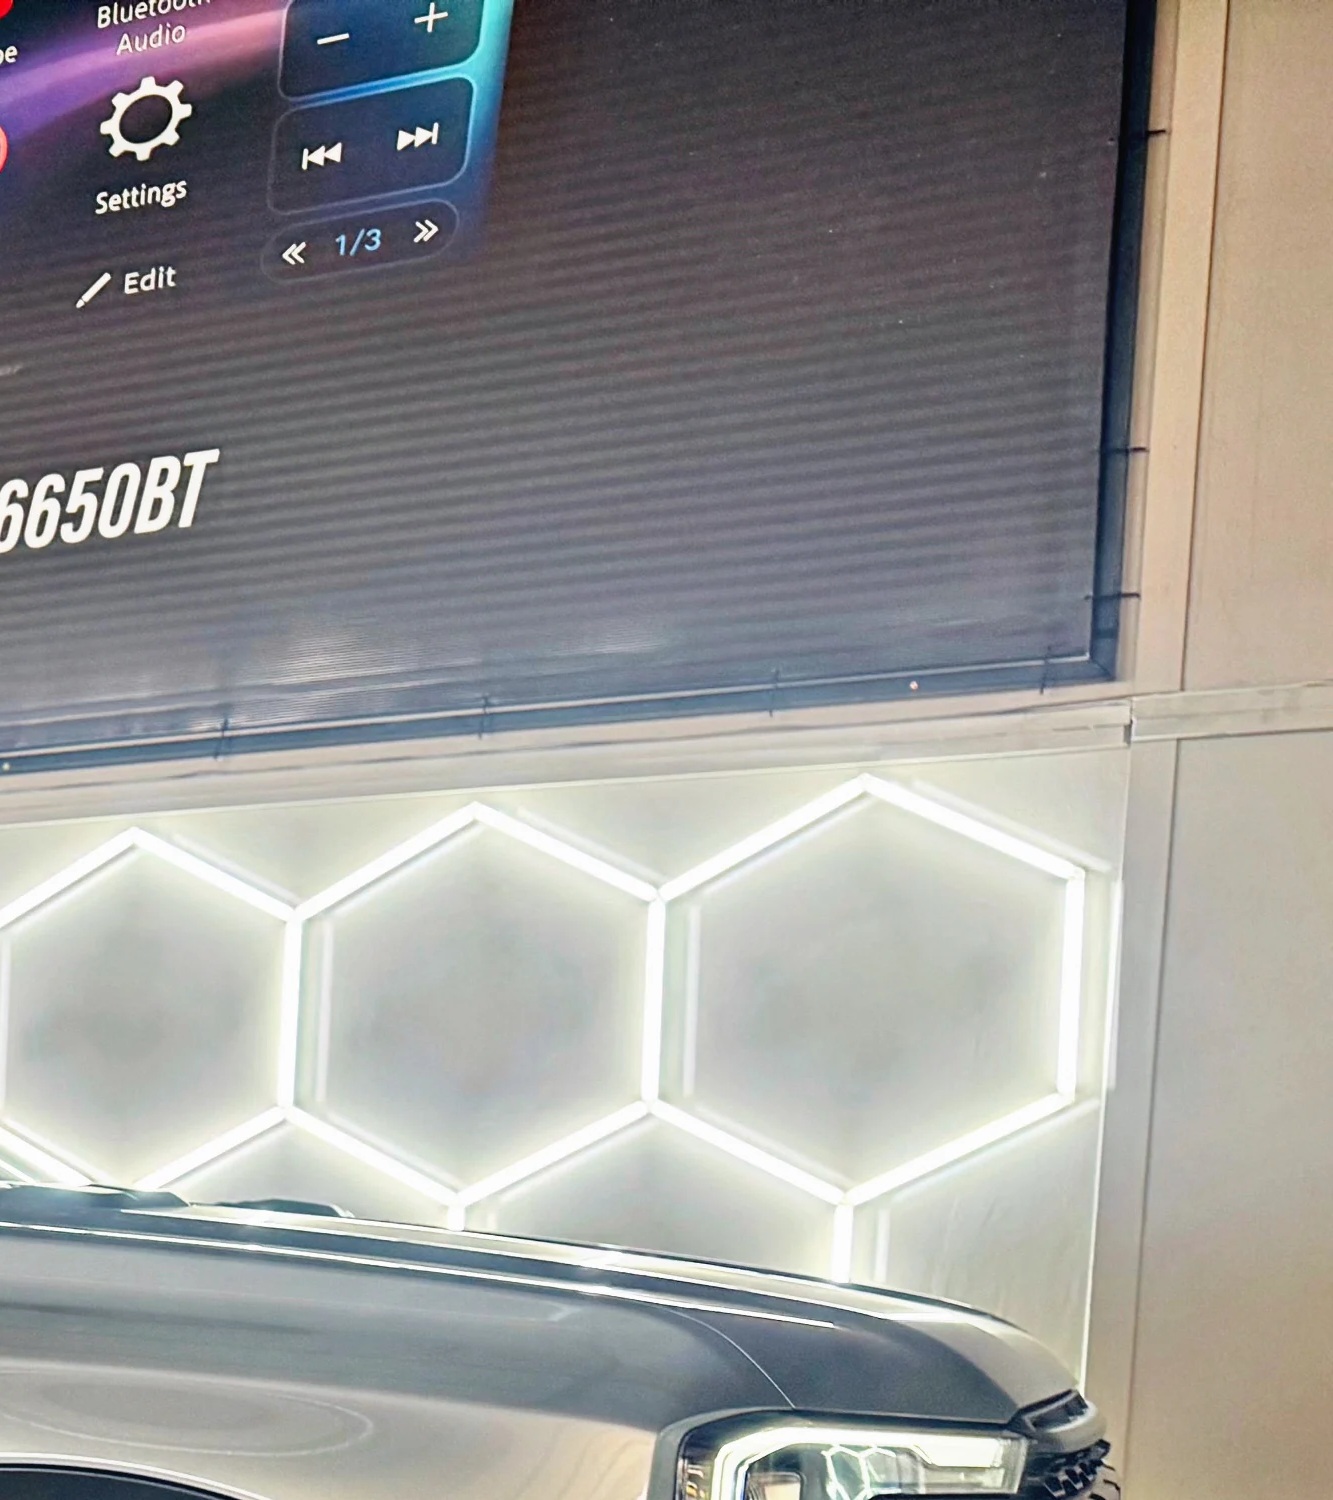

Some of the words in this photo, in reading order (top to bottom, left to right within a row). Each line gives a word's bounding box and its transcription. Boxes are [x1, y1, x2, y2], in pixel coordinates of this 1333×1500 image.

[97, 0, 212, 29] Bluetoo
[116, 22, 186, 56] Audio
[95, 180, 188, 215] Settings
[335, 228, 382, 257] 1/3
[123, 266, 177, 295] Edit
